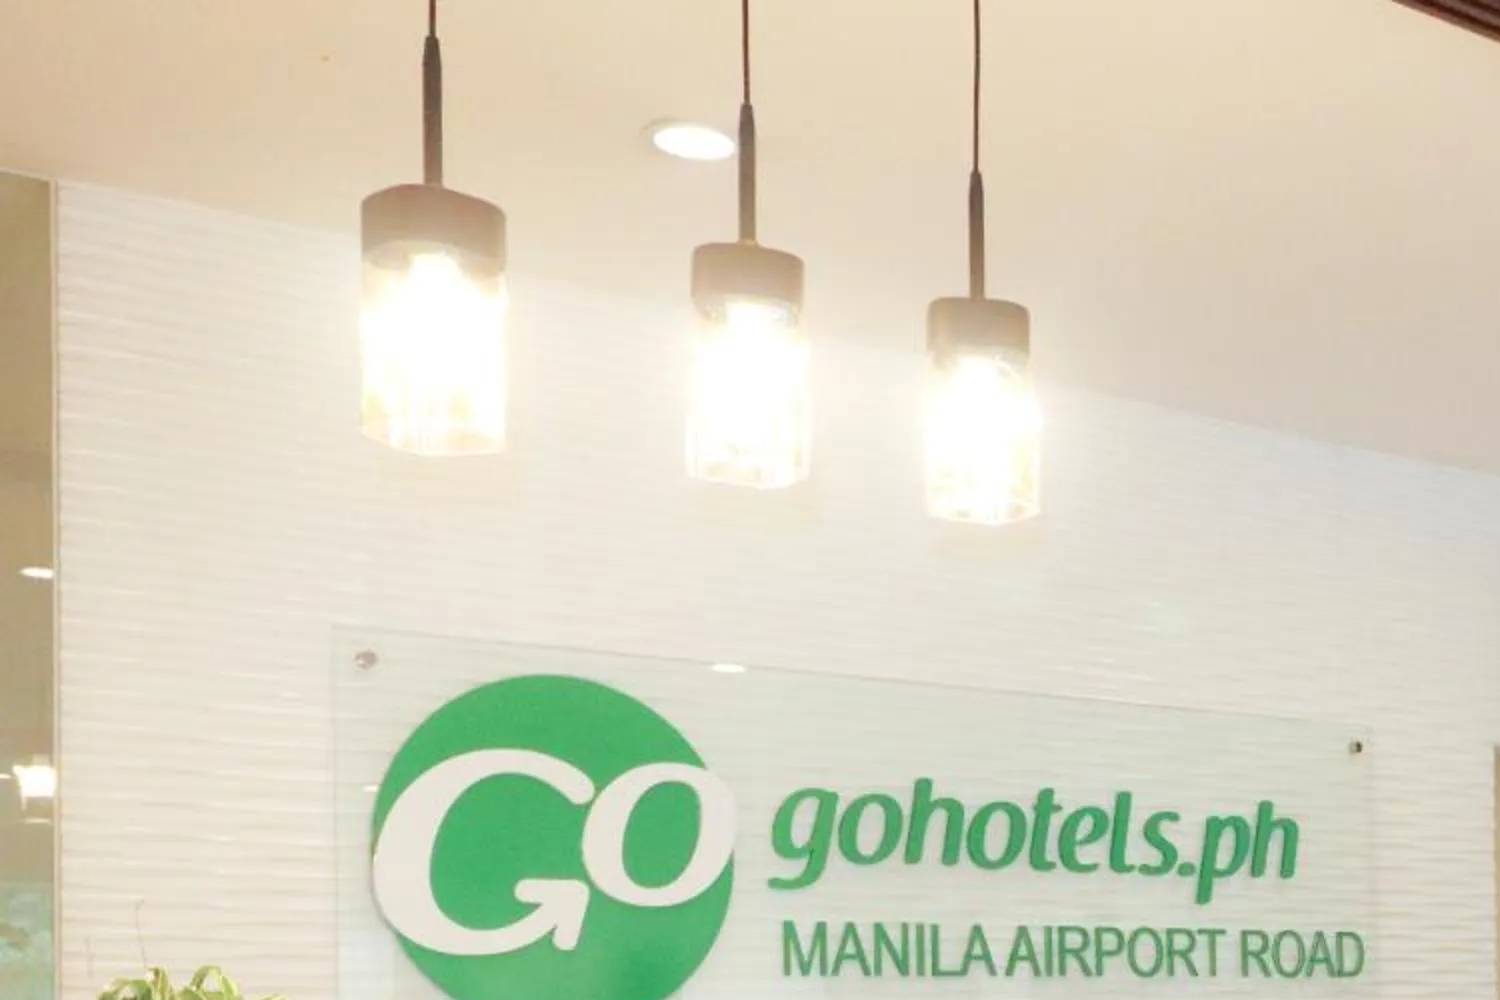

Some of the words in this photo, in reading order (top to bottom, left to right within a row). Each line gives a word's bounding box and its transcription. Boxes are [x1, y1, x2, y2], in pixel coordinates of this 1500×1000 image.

[768, 778, 1299, 905] gohotels.ph
[781, 921, 997, 978] MANILA
[1005, 926, 1227, 979] AIRPORT
[1240, 930, 1366, 979] ROAD
